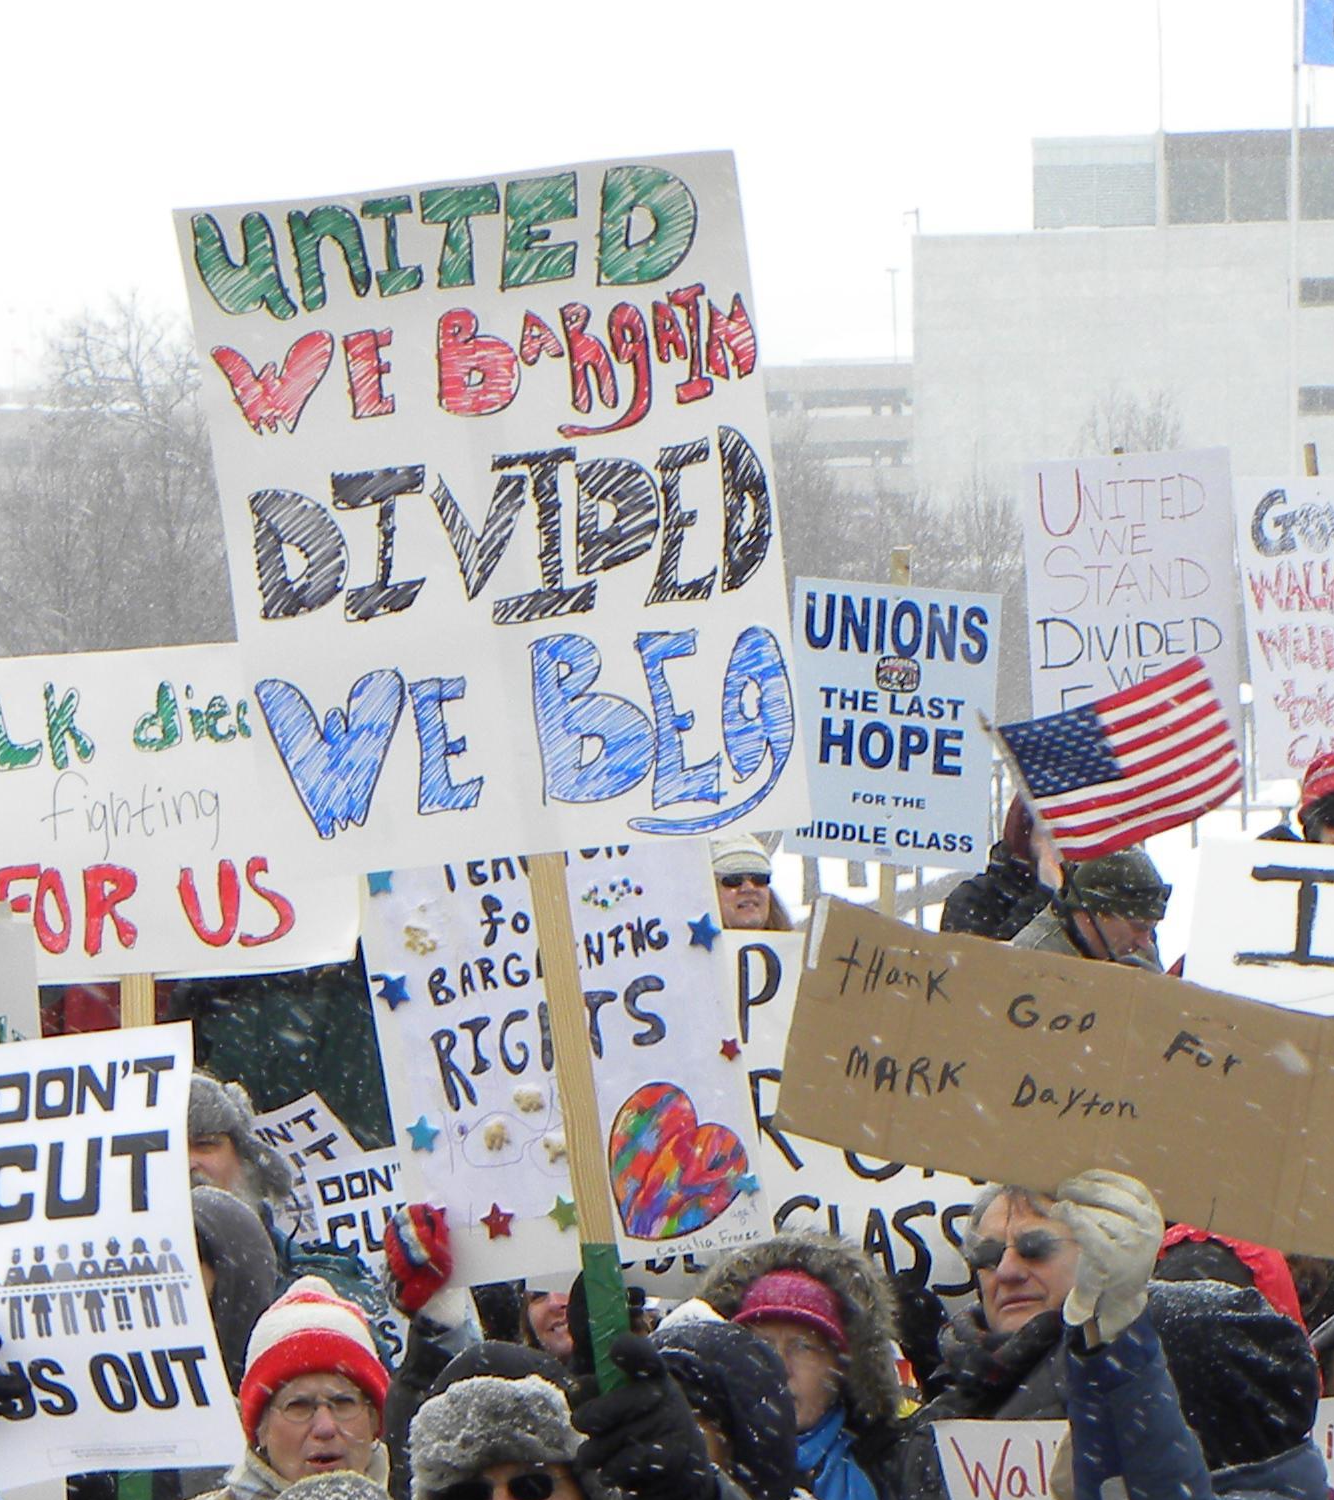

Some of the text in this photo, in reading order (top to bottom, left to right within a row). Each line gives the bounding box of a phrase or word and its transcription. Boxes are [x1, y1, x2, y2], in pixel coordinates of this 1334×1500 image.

[210, 328, 397, 436] WE
[248, 425, 773, 624] DIVIDED
[1037, 466, 1206, 538] UNITED
[1090, 524, 1153, 557] WE
[1042, 545, 1211, 614] STAND
[804, 590, 989, 665] UNIONS
[820, 686, 966, 720] THE LAST
[254, 666, 485, 839] WE
[820, 717, 964, 777] HOPE
[852, 792, 926, 810] FOR THE
[796, 820, 974, 853] MIDDLE CLASS
[177, 856, 296, 946] US
[481, 895, 530, 946] fo
[428, 918, 668, 1006] BARGNING
[845, 1044, 1139, 1121] MARK Dayton
[253, 1107, 317, 1148] N'T
[316, 1161, 402, 1206] DON'
[327, 1201, 407, 1254] CU
[89, 1344, 211, 1414] OUT
